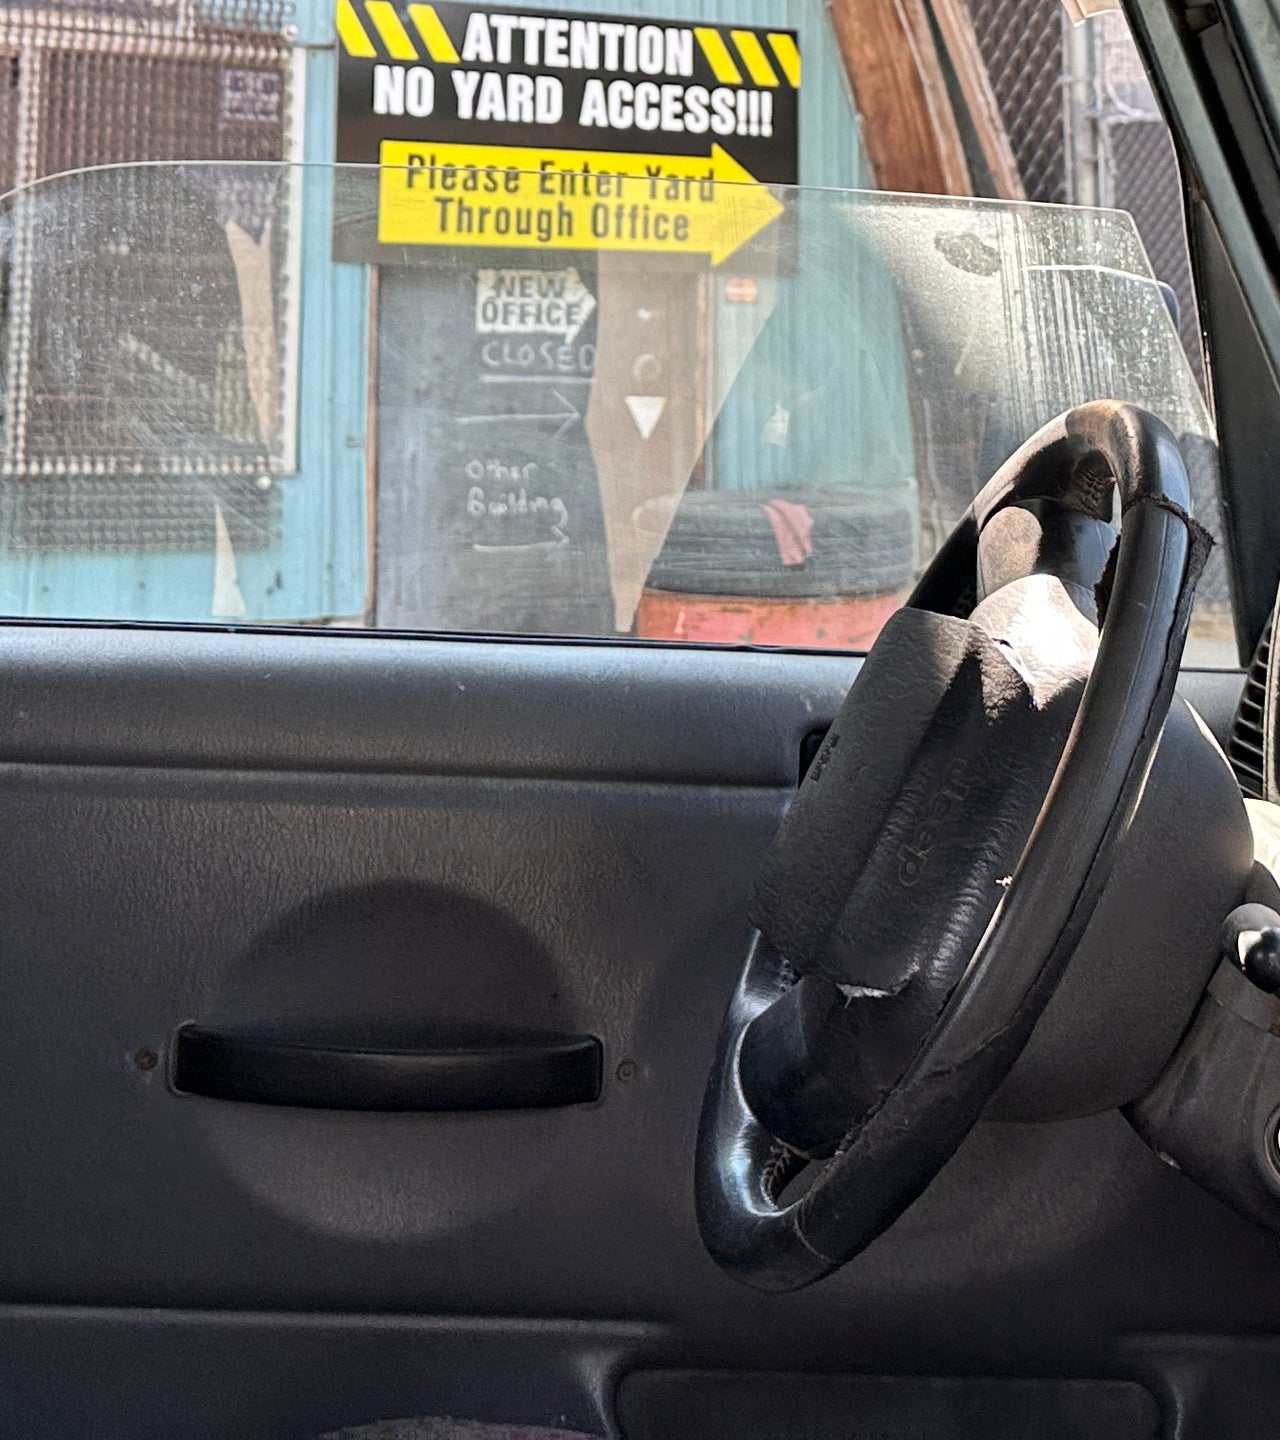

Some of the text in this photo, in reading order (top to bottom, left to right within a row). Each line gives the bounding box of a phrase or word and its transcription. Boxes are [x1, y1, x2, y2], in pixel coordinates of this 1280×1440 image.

[462, 12, 695, 77] ATTENTION
[373, 63, 774, 138] NO YARD ACCESS!!!
[406, 152, 716, 202] Please Enter Yard
[434, 196, 691, 243] Through Office
[495, 274, 564, 298] NEW
[481, 297, 583, 327] OFFICE
[481, 340, 597, 373] CLOSED
[897, 757, 970, 888] Jeep
